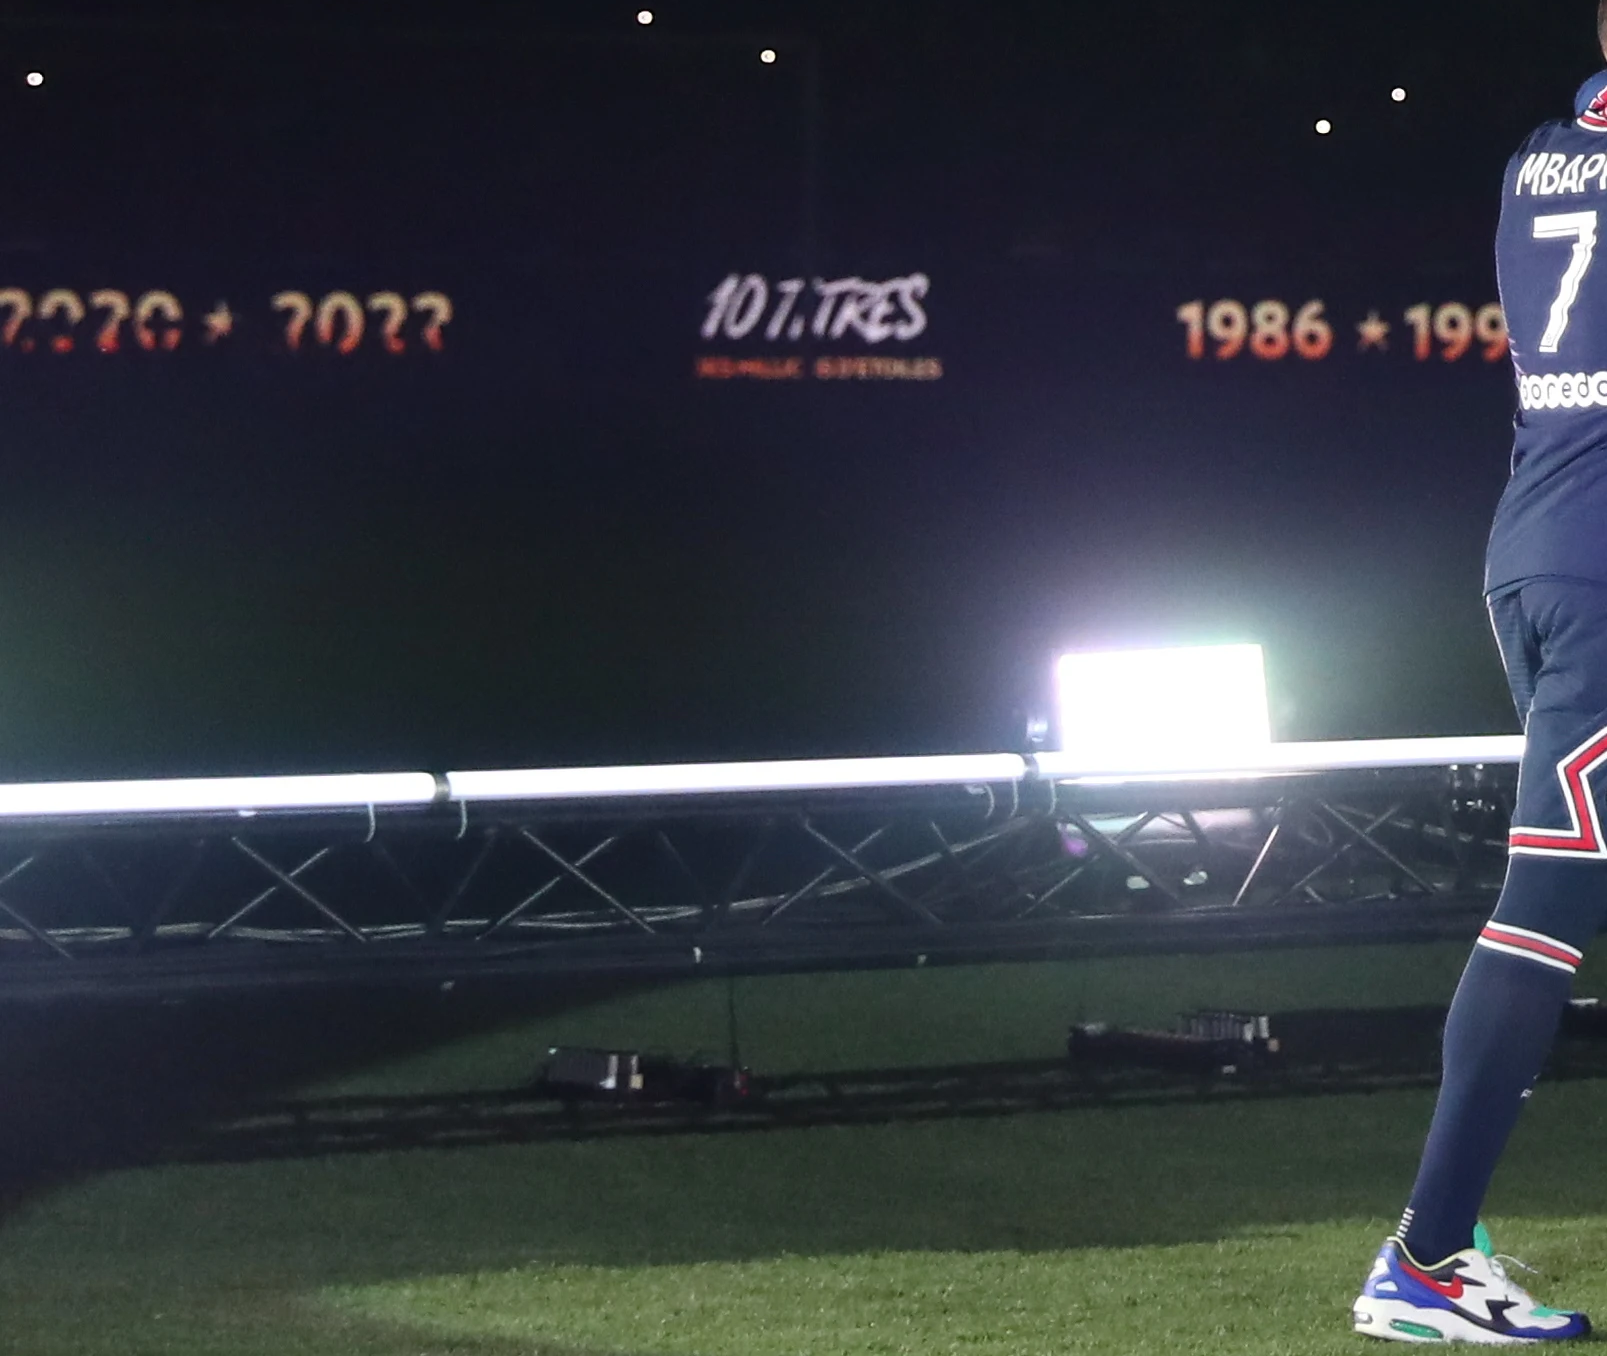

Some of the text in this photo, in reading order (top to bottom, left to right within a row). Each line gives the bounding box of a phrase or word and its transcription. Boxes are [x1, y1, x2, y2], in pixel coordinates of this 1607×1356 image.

[701, 272, 768, 340] 10
[1532, 210, 1597, 353] 7
[1175, 299, 1335, 361] 1986
[1403, 302, 1509, 363] 199
